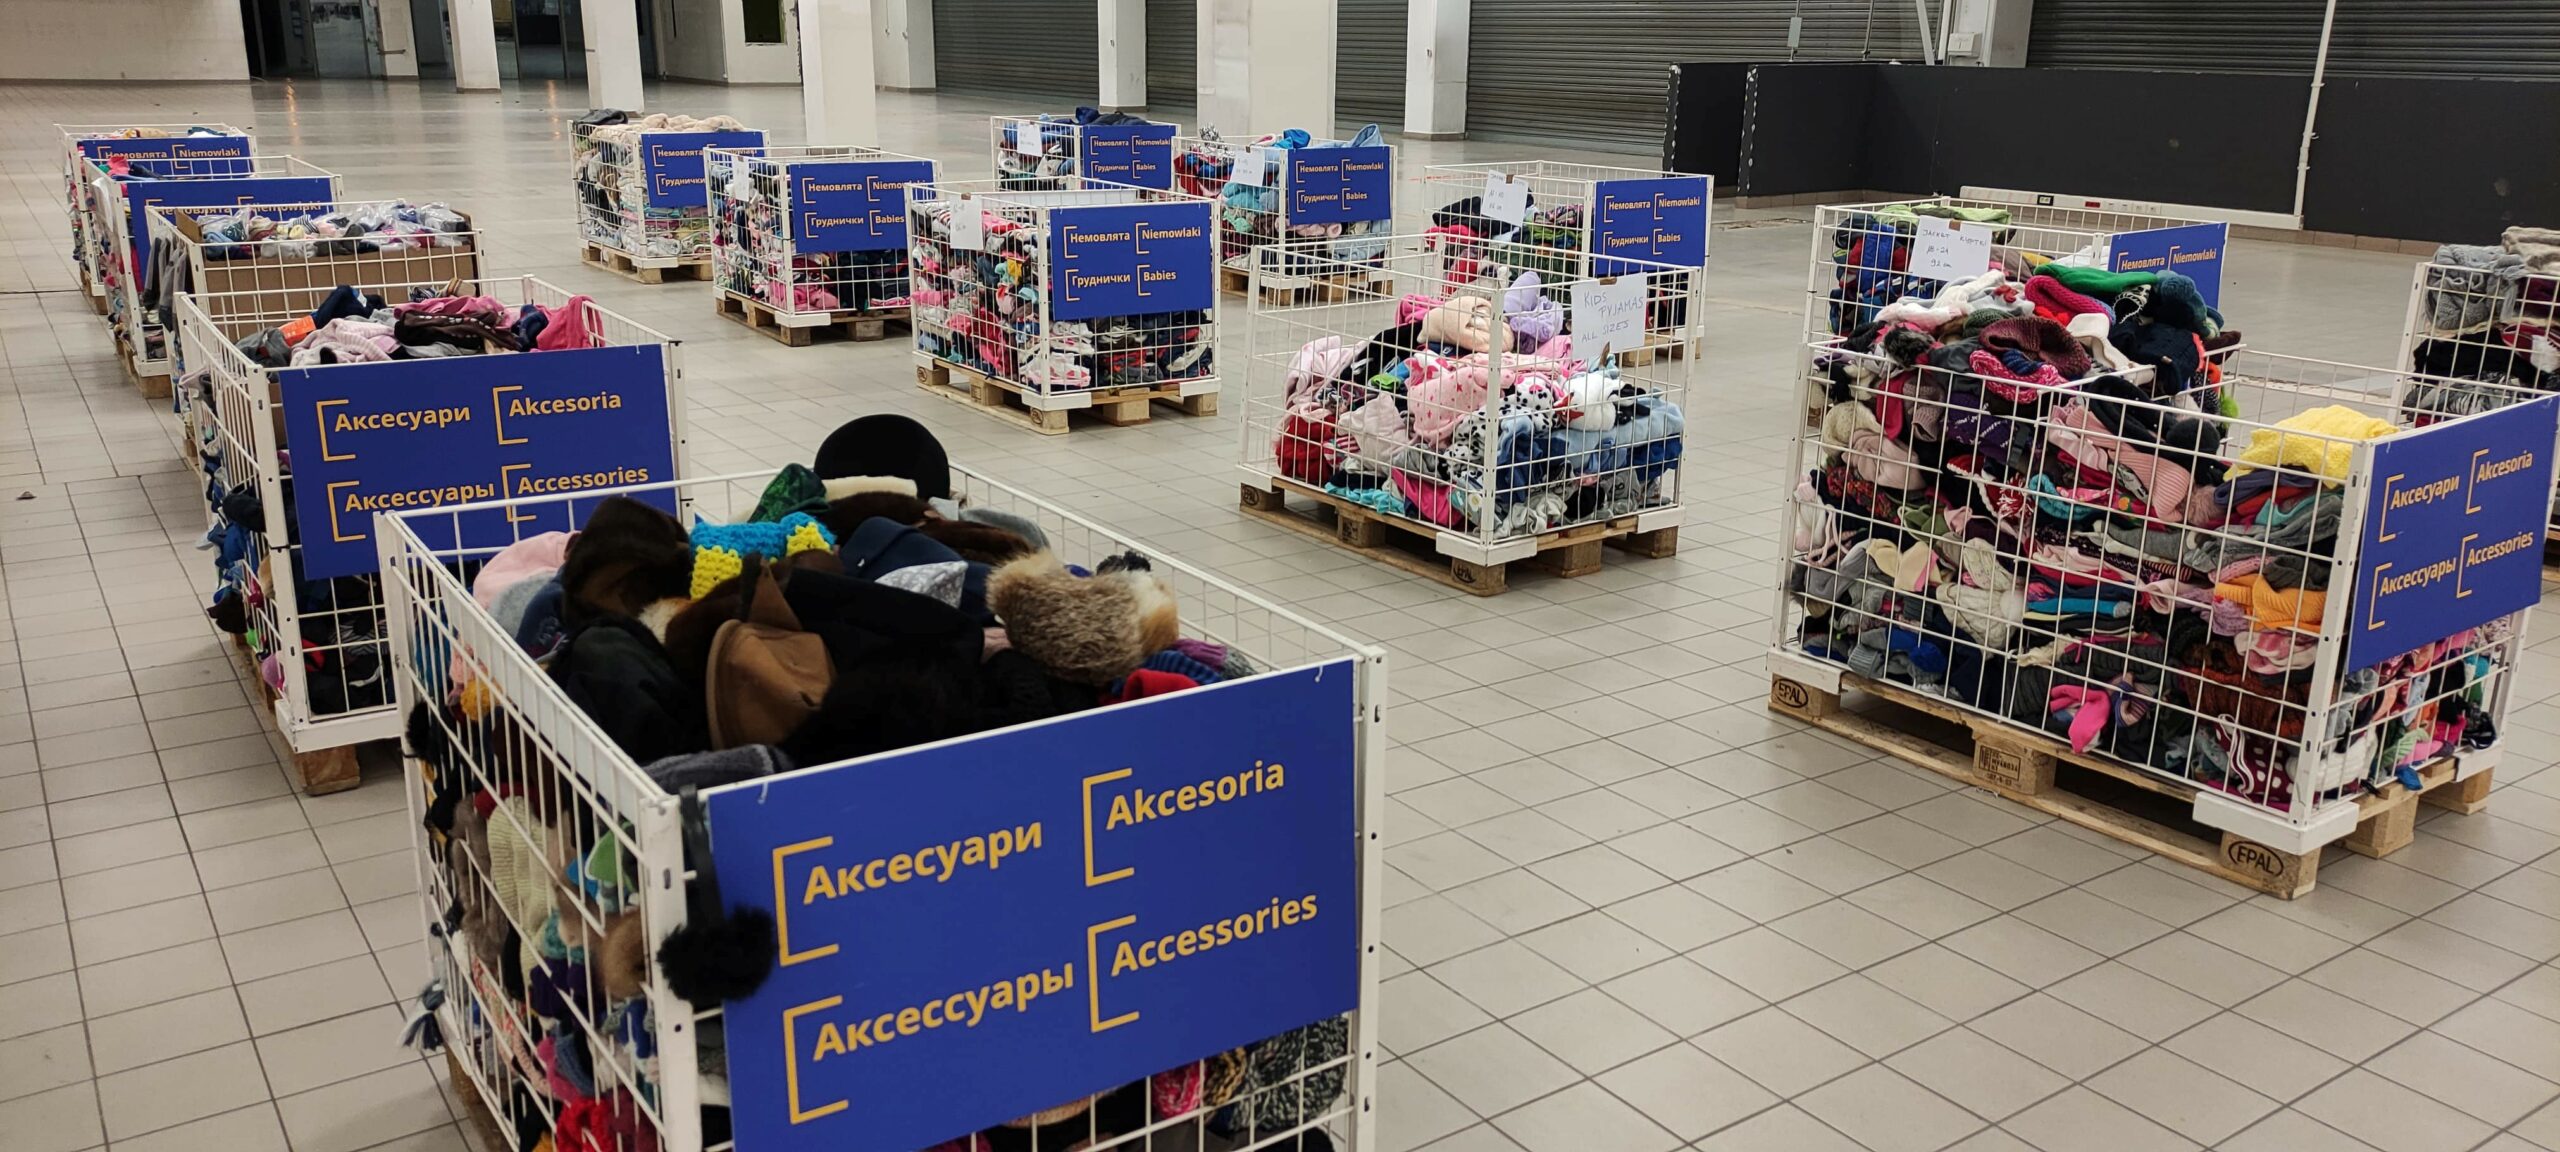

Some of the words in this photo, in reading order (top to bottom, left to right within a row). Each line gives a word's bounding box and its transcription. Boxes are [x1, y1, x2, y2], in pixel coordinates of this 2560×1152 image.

[1135, 138, 1171, 146] Niemowlaki
[179, 148, 241, 158] Niemowlaki
[1094, 164, 1129, 173] Груднички
[1136, 163, 1156, 171] Babies
[1299, 165, 1339, 173] Немовлята
[1345, 162, 1384, 172] Niemowlaki
[661, 177, 705, 187] Груднички
[808, 182, 863, 192] Немовлята
[1300, 194, 1339, 204] Груднички
[1346, 192, 1368, 200] Babies
[1658, 197, 1700, 207] Niemowlaki
[1608, 200, 1651, 210] Немовлята
[810, 217, 864, 228] Груднички
[875, 214, 905, 224] Babies
[1070, 231, 1131, 243] Немовлята
[1142, 226, 1201, 240] Niemowlaki
[1657, 233, 1681, 243] Babies
[1607, 237, 1649, 247] Груднички
[2172, 248, 2217, 265] Niemowlaki
[2121, 257, 2166, 271] Немовлята
[1072, 274, 1131, 288] Груднички
[1144, 270, 1177, 282] Babies
[1583, 290, 1608, 308] KIDS
[1599, 296, 1645, 318] PYJAMAS
[1581, 331, 1598, 343] ALL
[508, 391, 622, 417] Akcesoria
[334, 406, 471, 433] Аксесуари
[2476, 450, 2533, 483] Akcesoria
[517, 466, 649, 495] Accessories
[345, 483, 495, 512] Аксессуары
[2390, 475, 2460, 510] Аксесуари
[2466, 532, 2534, 567] Accessories
[2379, 557, 2457, 597] Аксессуары
[1778, 682, 1803, 705] EPAL
[1106, 760, 1284, 830] Akcesoria
[803, 822, 1042, 905] Аксесуари
[2236, 845, 2275, 875] EPAL
[1111, 895, 1318, 977] Accessories
[813, 963, 1073, 1061] Аксессуары
